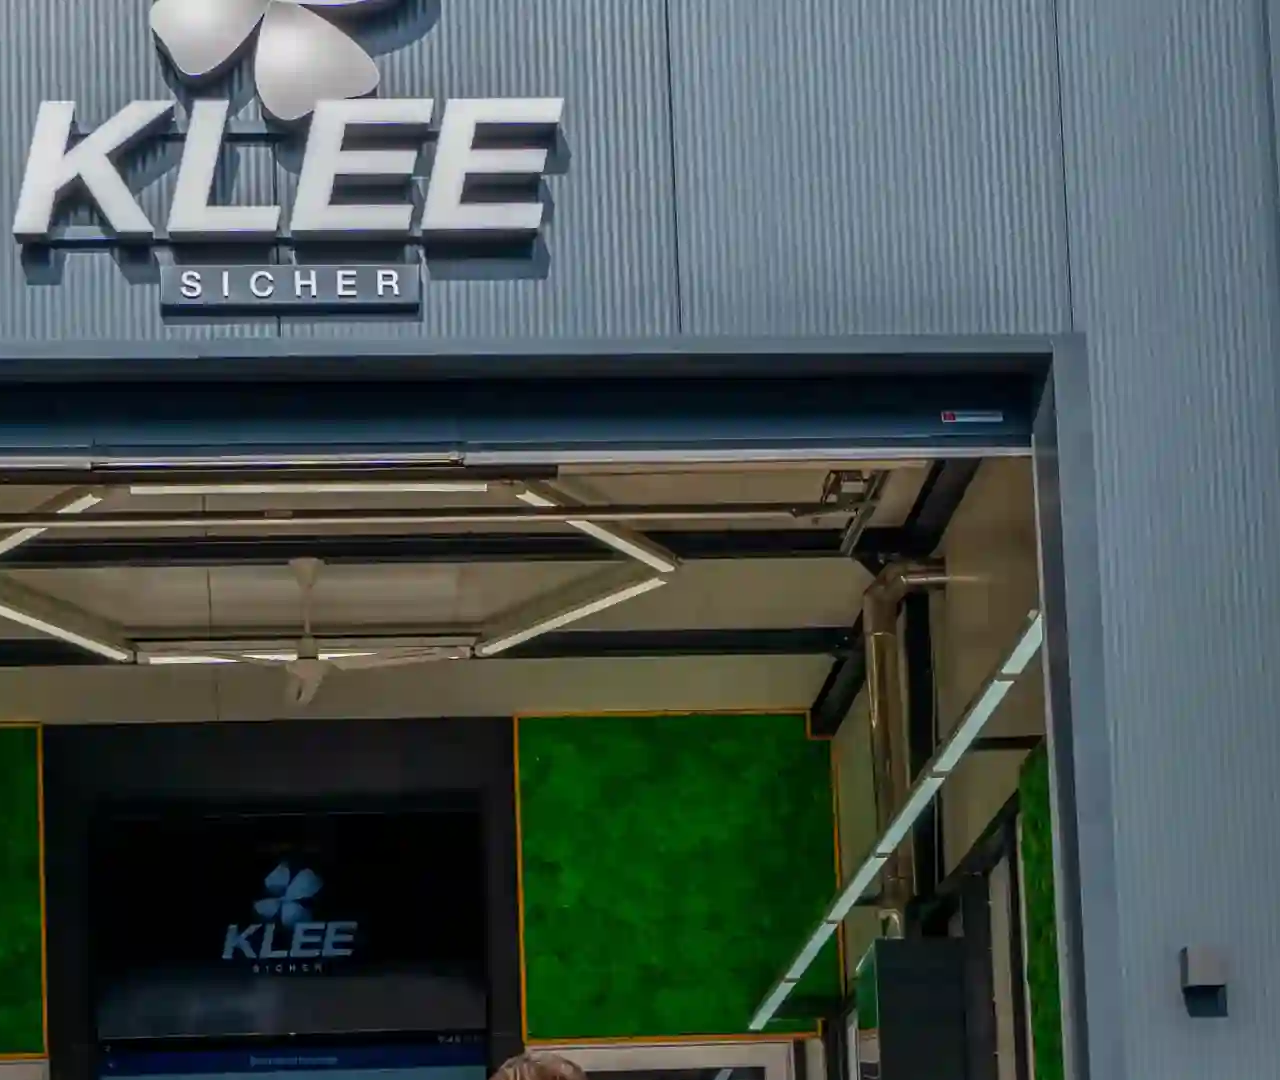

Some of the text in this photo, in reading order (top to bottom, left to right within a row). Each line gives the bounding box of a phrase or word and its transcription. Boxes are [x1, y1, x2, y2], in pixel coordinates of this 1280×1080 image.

[13, 97, 564, 238] KLEE
[180, 269, 400, 297] SICHER
[221, 921, 358, 959] KLEE
